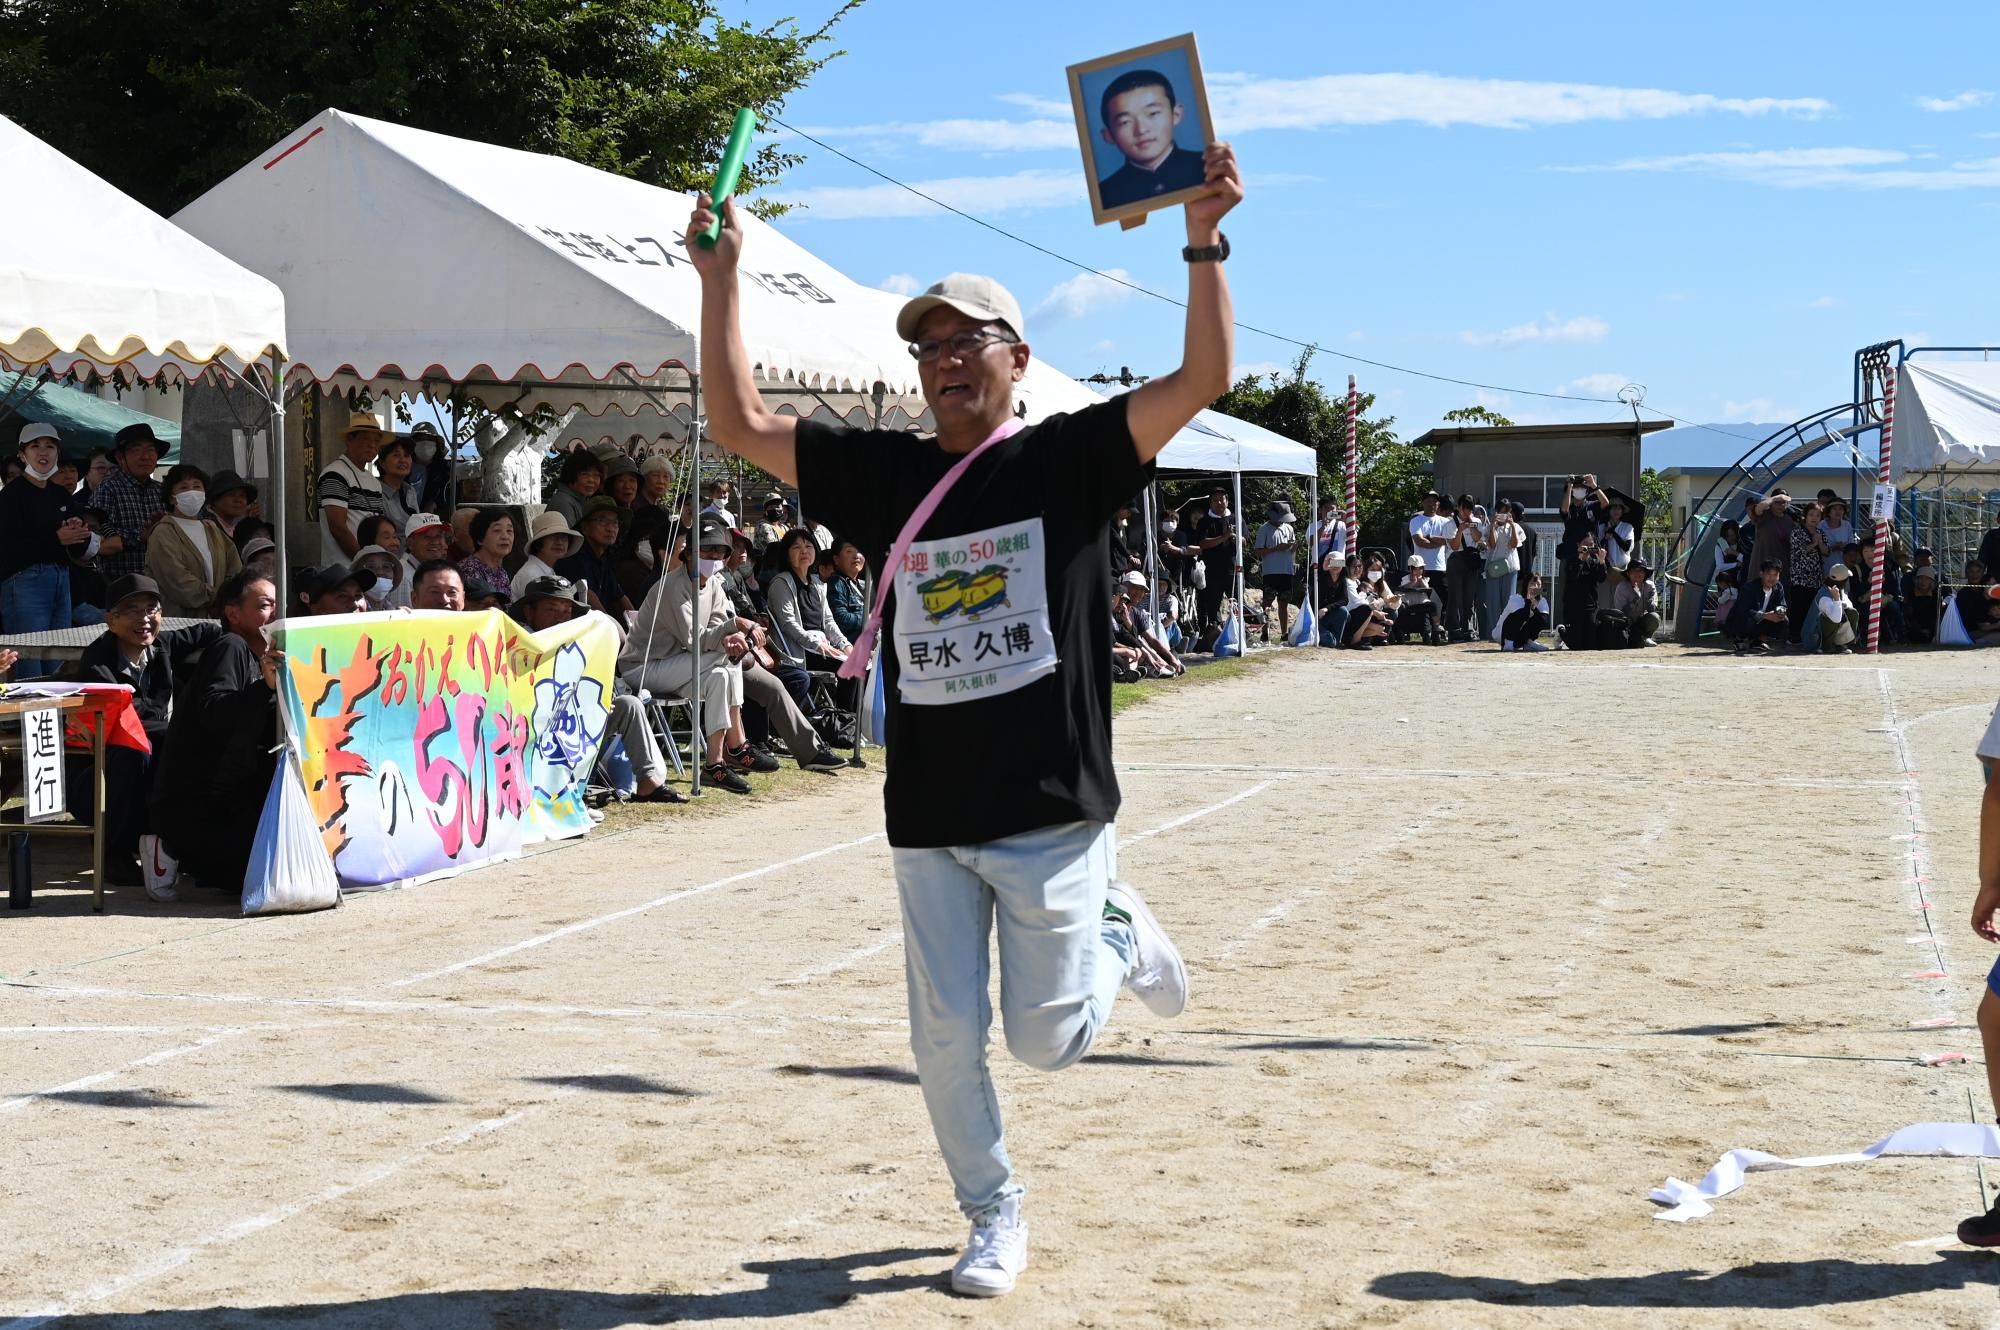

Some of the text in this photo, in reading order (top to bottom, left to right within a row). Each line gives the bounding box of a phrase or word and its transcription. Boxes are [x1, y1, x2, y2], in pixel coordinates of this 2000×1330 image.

[933, 532, 1031, 569] 華の50歳組
[909, 622, 1034, 672] 早水 久博
[944, 672, 998, 694] 阿久根市
[31, 711, 57, 812] 進行
